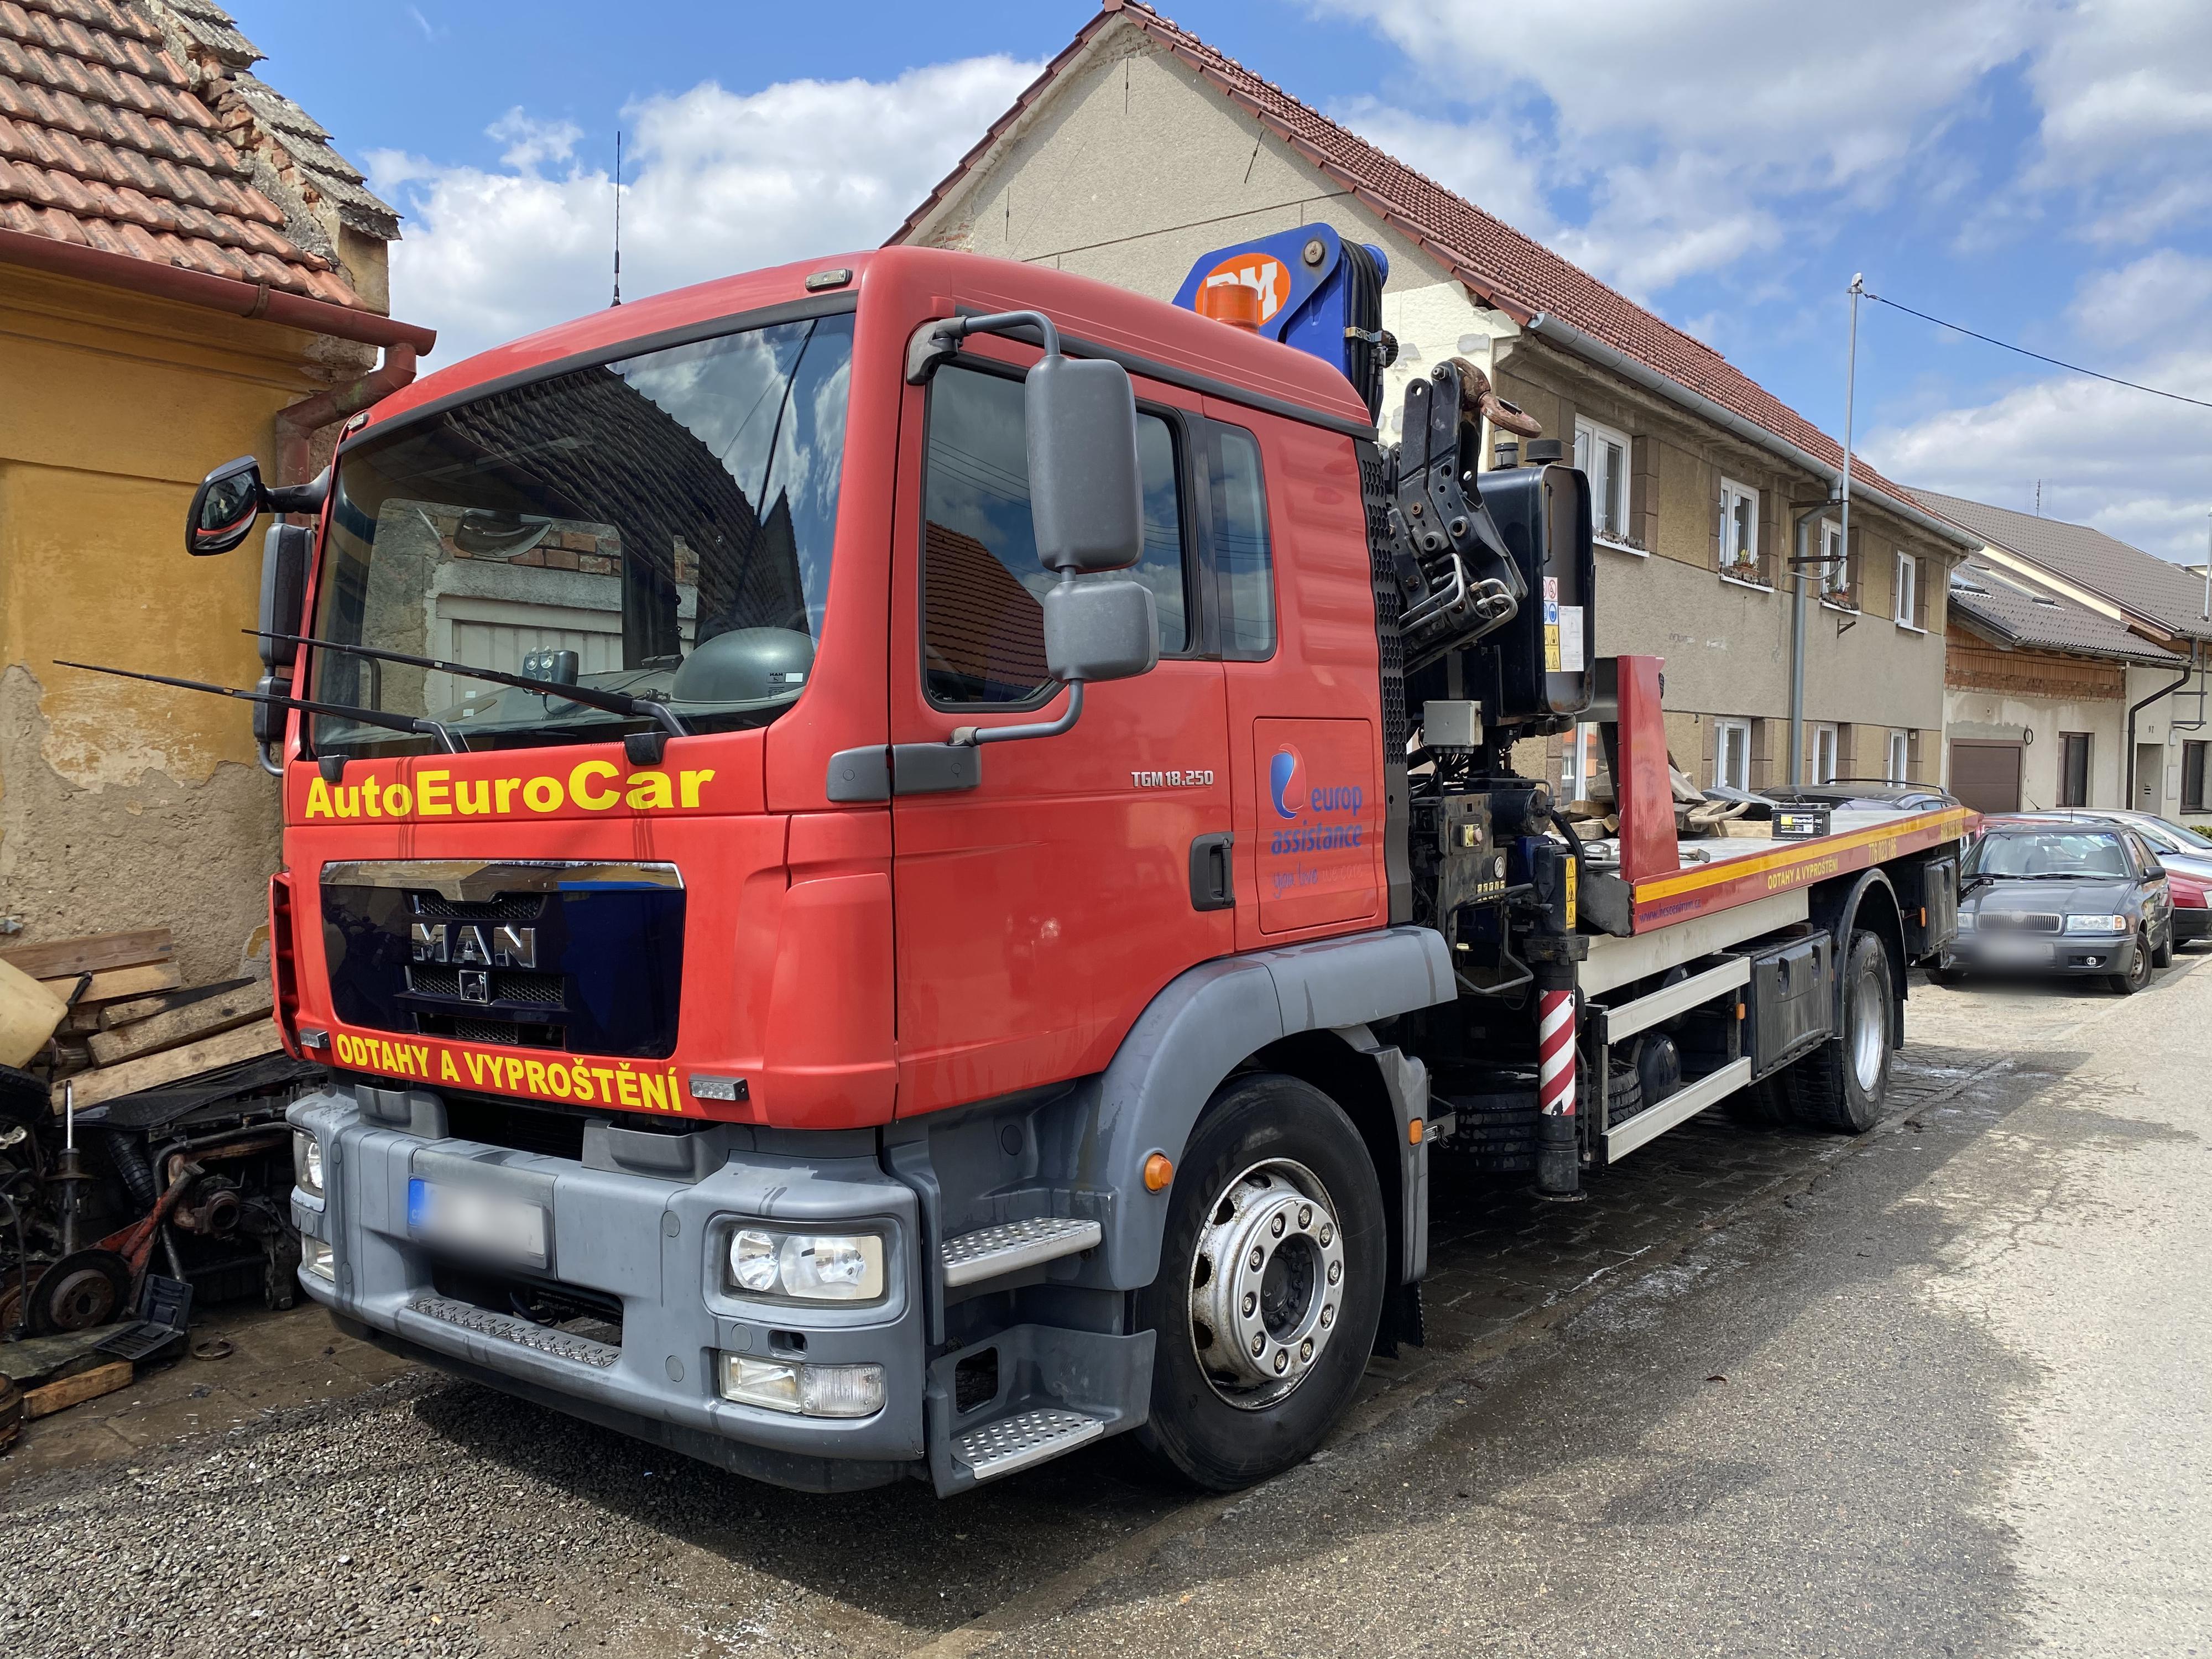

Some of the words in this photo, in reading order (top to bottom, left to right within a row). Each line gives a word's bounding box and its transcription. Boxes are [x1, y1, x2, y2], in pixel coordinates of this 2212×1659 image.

[305, 760, 715, 818] AutoEuroCar
[1131, 771, 1163, 787] TGM
[1165, 770, 1214, 786] 18.250
[1311, 786, 1363, 816] europ
[1271, 820, 1363, 854] assistance
[1767, 869, 1794, 890] ODTAHY
[1796, 868, 1801, 881] A
[411, 922, 536, 968] MAN
[337, 1034, 428, 1077] ODTAHY
[441, 1050, 460, 1082] A
[463, 1052, 682, 1112] VYPROŠTĚNÍ
